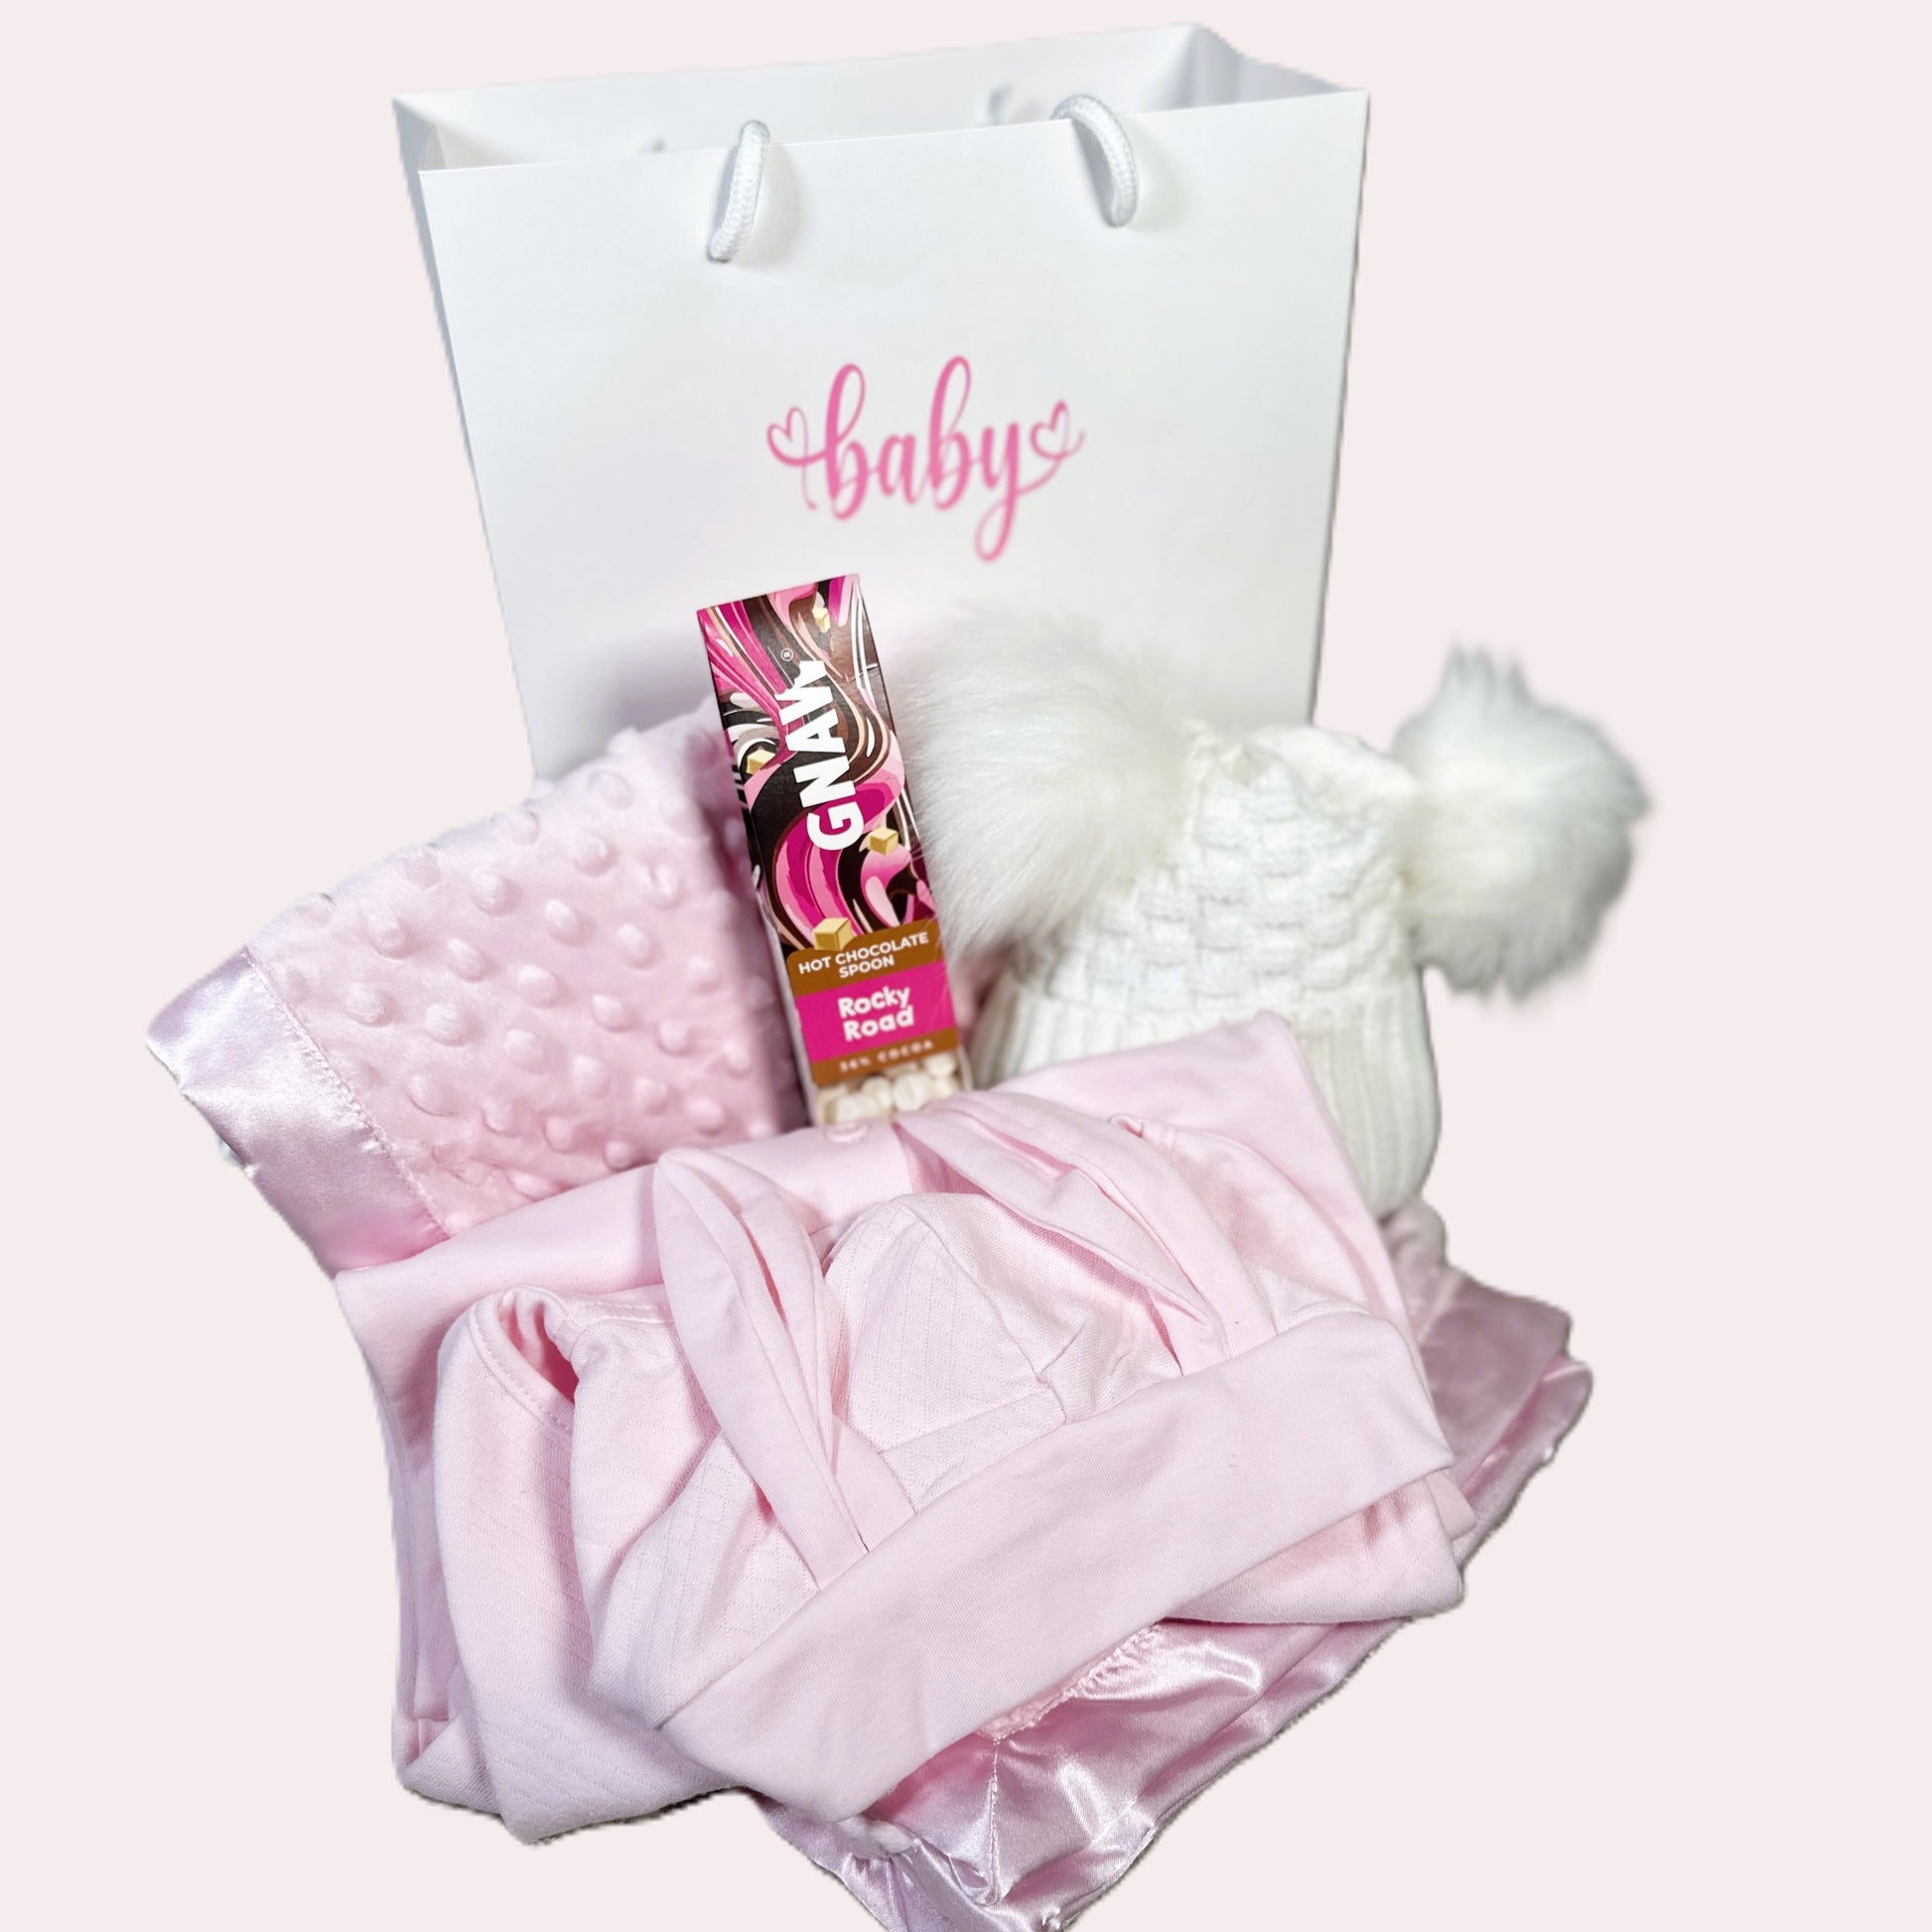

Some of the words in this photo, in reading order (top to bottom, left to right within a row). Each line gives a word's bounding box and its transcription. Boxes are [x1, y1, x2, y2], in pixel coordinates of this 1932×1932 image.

[766, 355, 1085, 563] baby
[773, 659, 865, 851] GNAW
[798, 955, 832, 975] HOT
[835, 931, 929, 965] CHOCOLATE
[838, 954, 896, 979] SPOON
[837, 986, 910, 1019] Rocky
[843, 1005, 914, 1041] Road
[877, 1038, 934, 1063] COCOA
